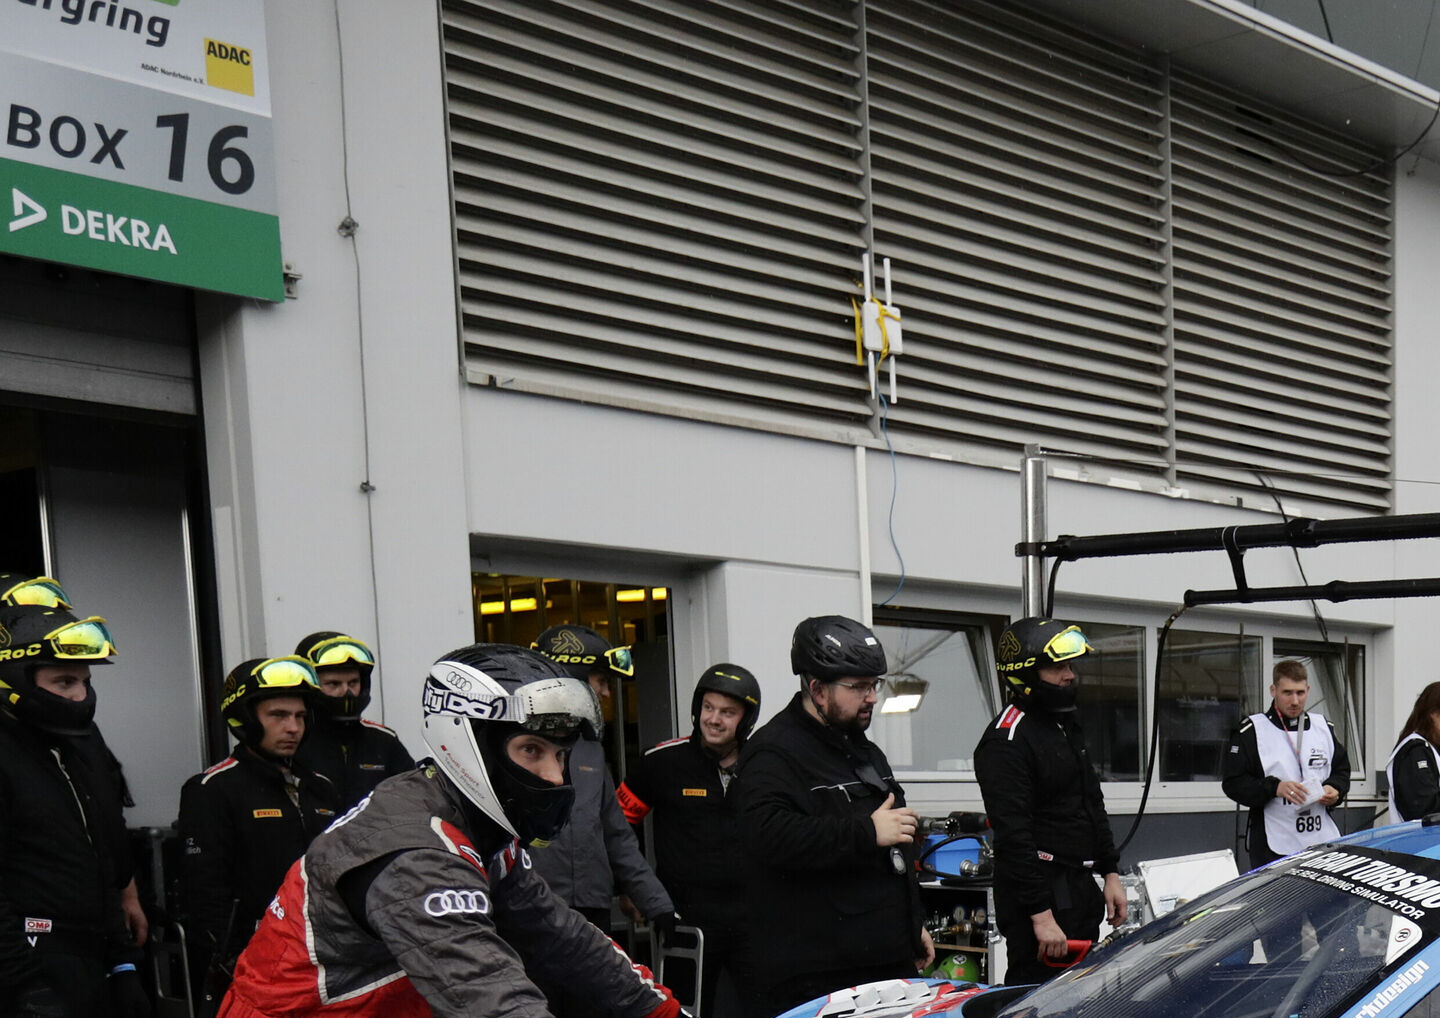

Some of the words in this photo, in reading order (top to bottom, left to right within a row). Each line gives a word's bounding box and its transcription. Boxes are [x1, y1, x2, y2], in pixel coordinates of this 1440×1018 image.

[207, 41, 250, 66] ADAC
[140, 62, 158, 74] ADAC
[160, 66, 192, 82] Nordrhein
[7, 103, 128, 171] BOX
[156, 112, 255, 196] 16
[61, 204, 178, 255] DEKRA
[1295, 814, 1322, 833] 689
[1311, 850, 1355, 876] GRAN
[1315, 873, 1353, 893] DRIVING
[1350, 885, 1424, 920] SIMULATOR
[27, 920, 51, 930] OMP
